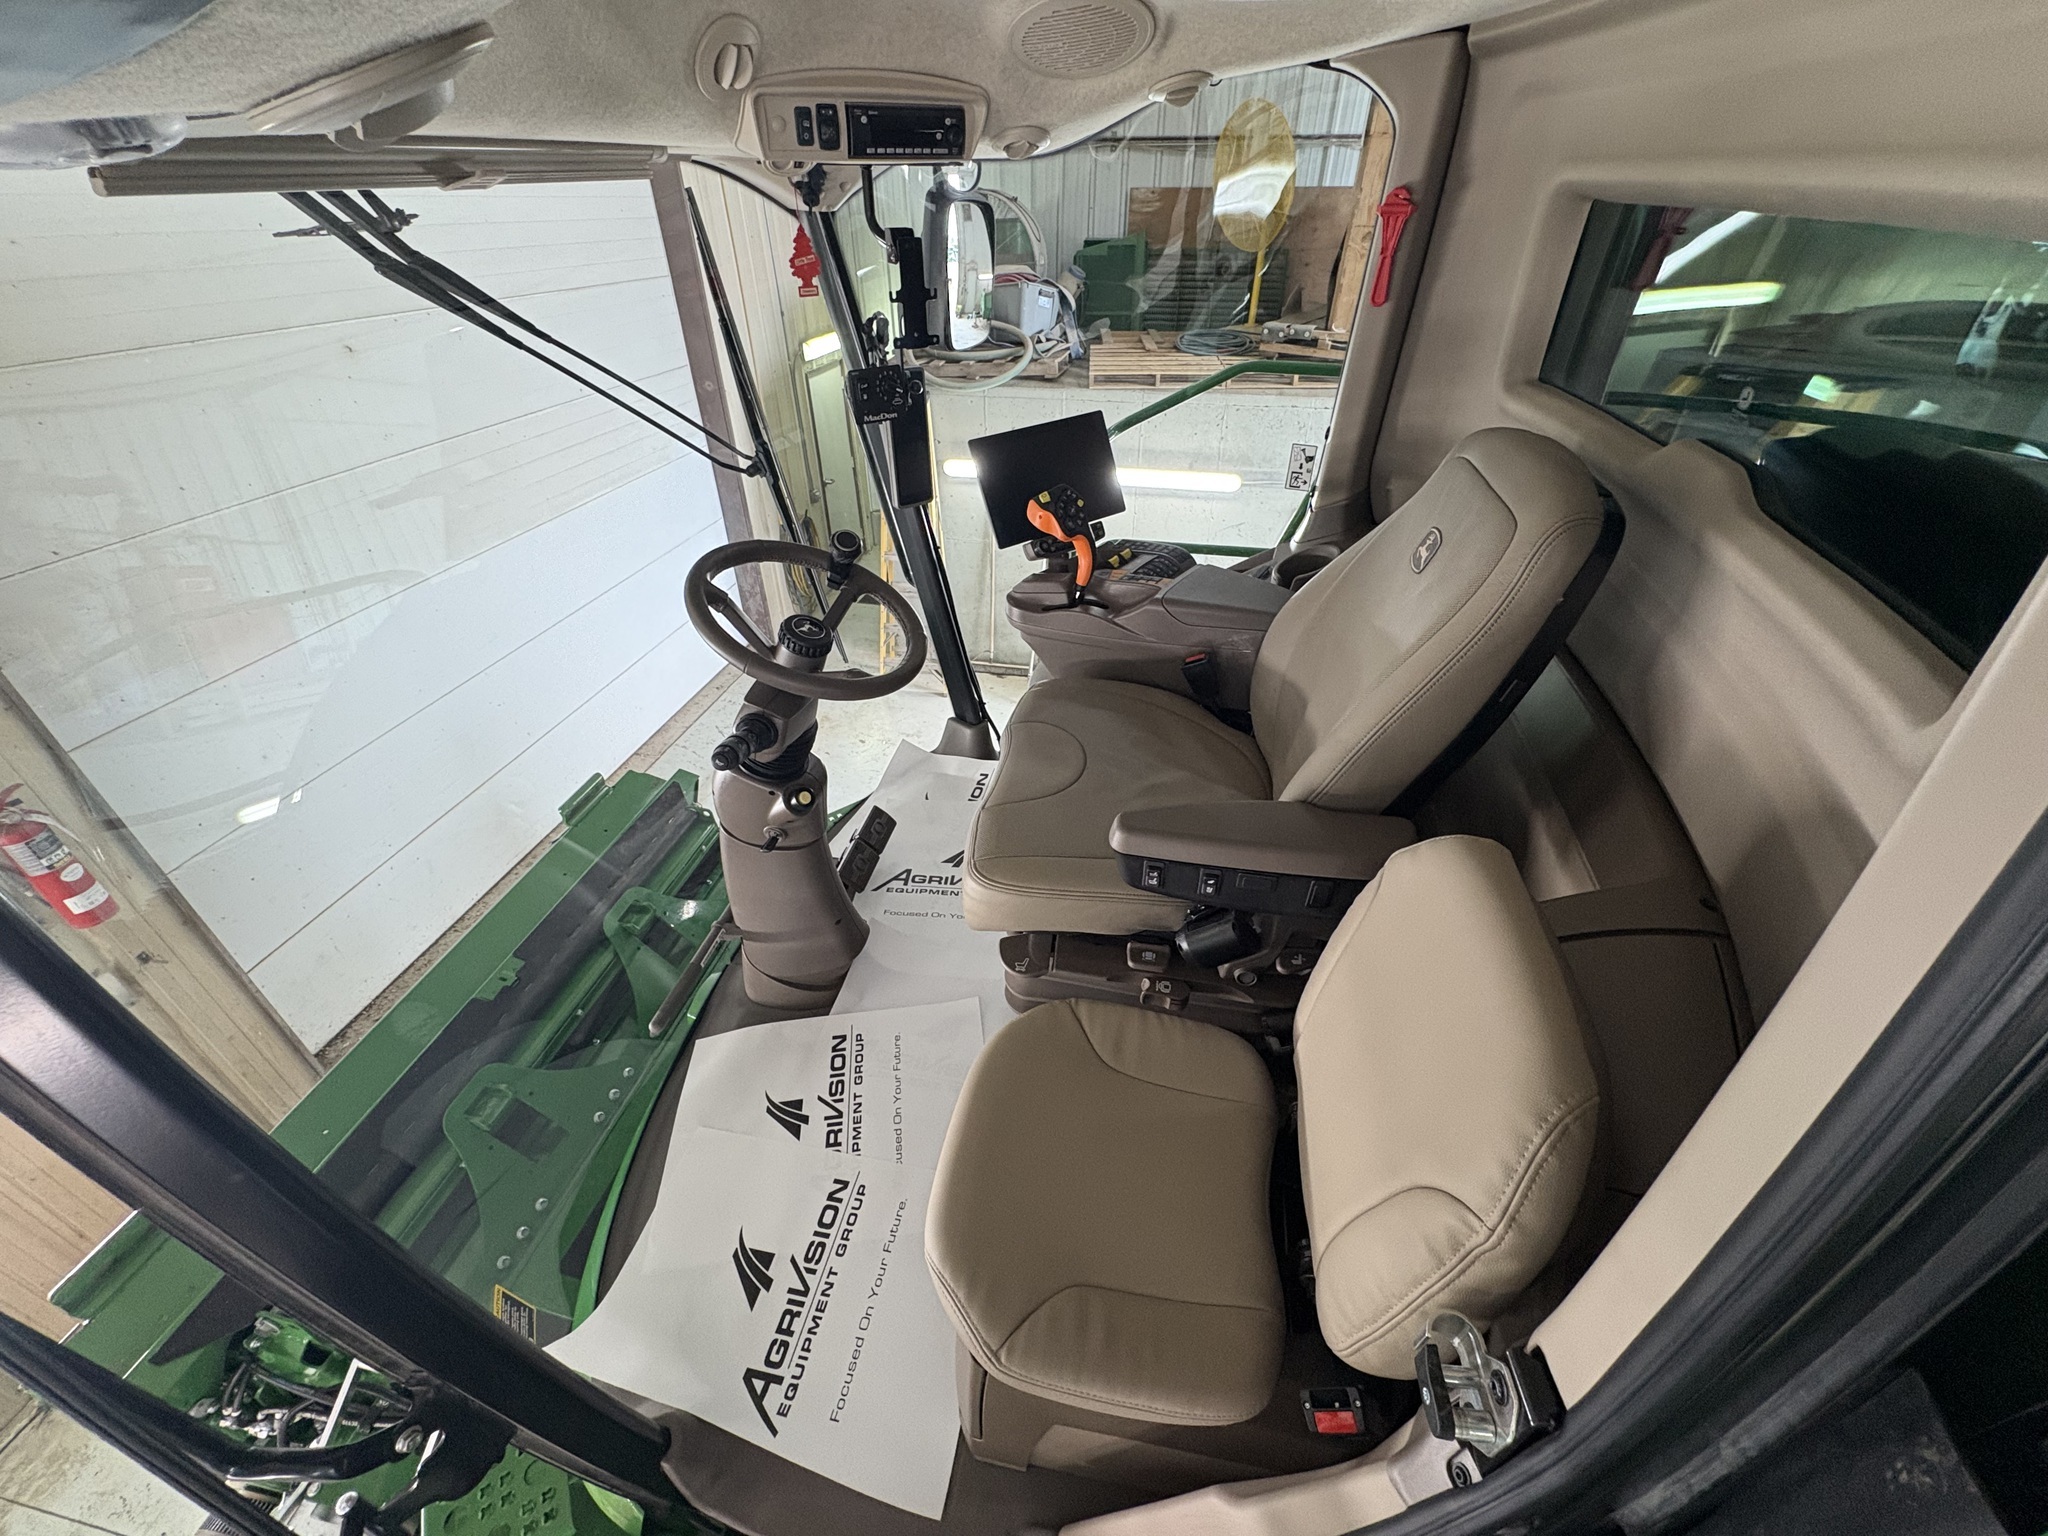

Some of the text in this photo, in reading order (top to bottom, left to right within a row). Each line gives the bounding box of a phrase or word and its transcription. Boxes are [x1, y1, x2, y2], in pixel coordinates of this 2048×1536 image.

[864, 413, 897, 421] MacDon
[886, 887, 963, 896] EQUIPMEN
[884, 909, 928, 917] Focused
[854, 1033, 864, 1085] GROUP
[893, 1032, 902, 1071] Future.
[817, 1034, 847, 1153] RIVISION
[893, 1075, 902, 1104] Your
[893, 1107, 902, 1125] On
[776, 1184, 868, 1418] EQUIPMENT GROUP
[829, 1198, 908, 1423] Focused On Your Future.
